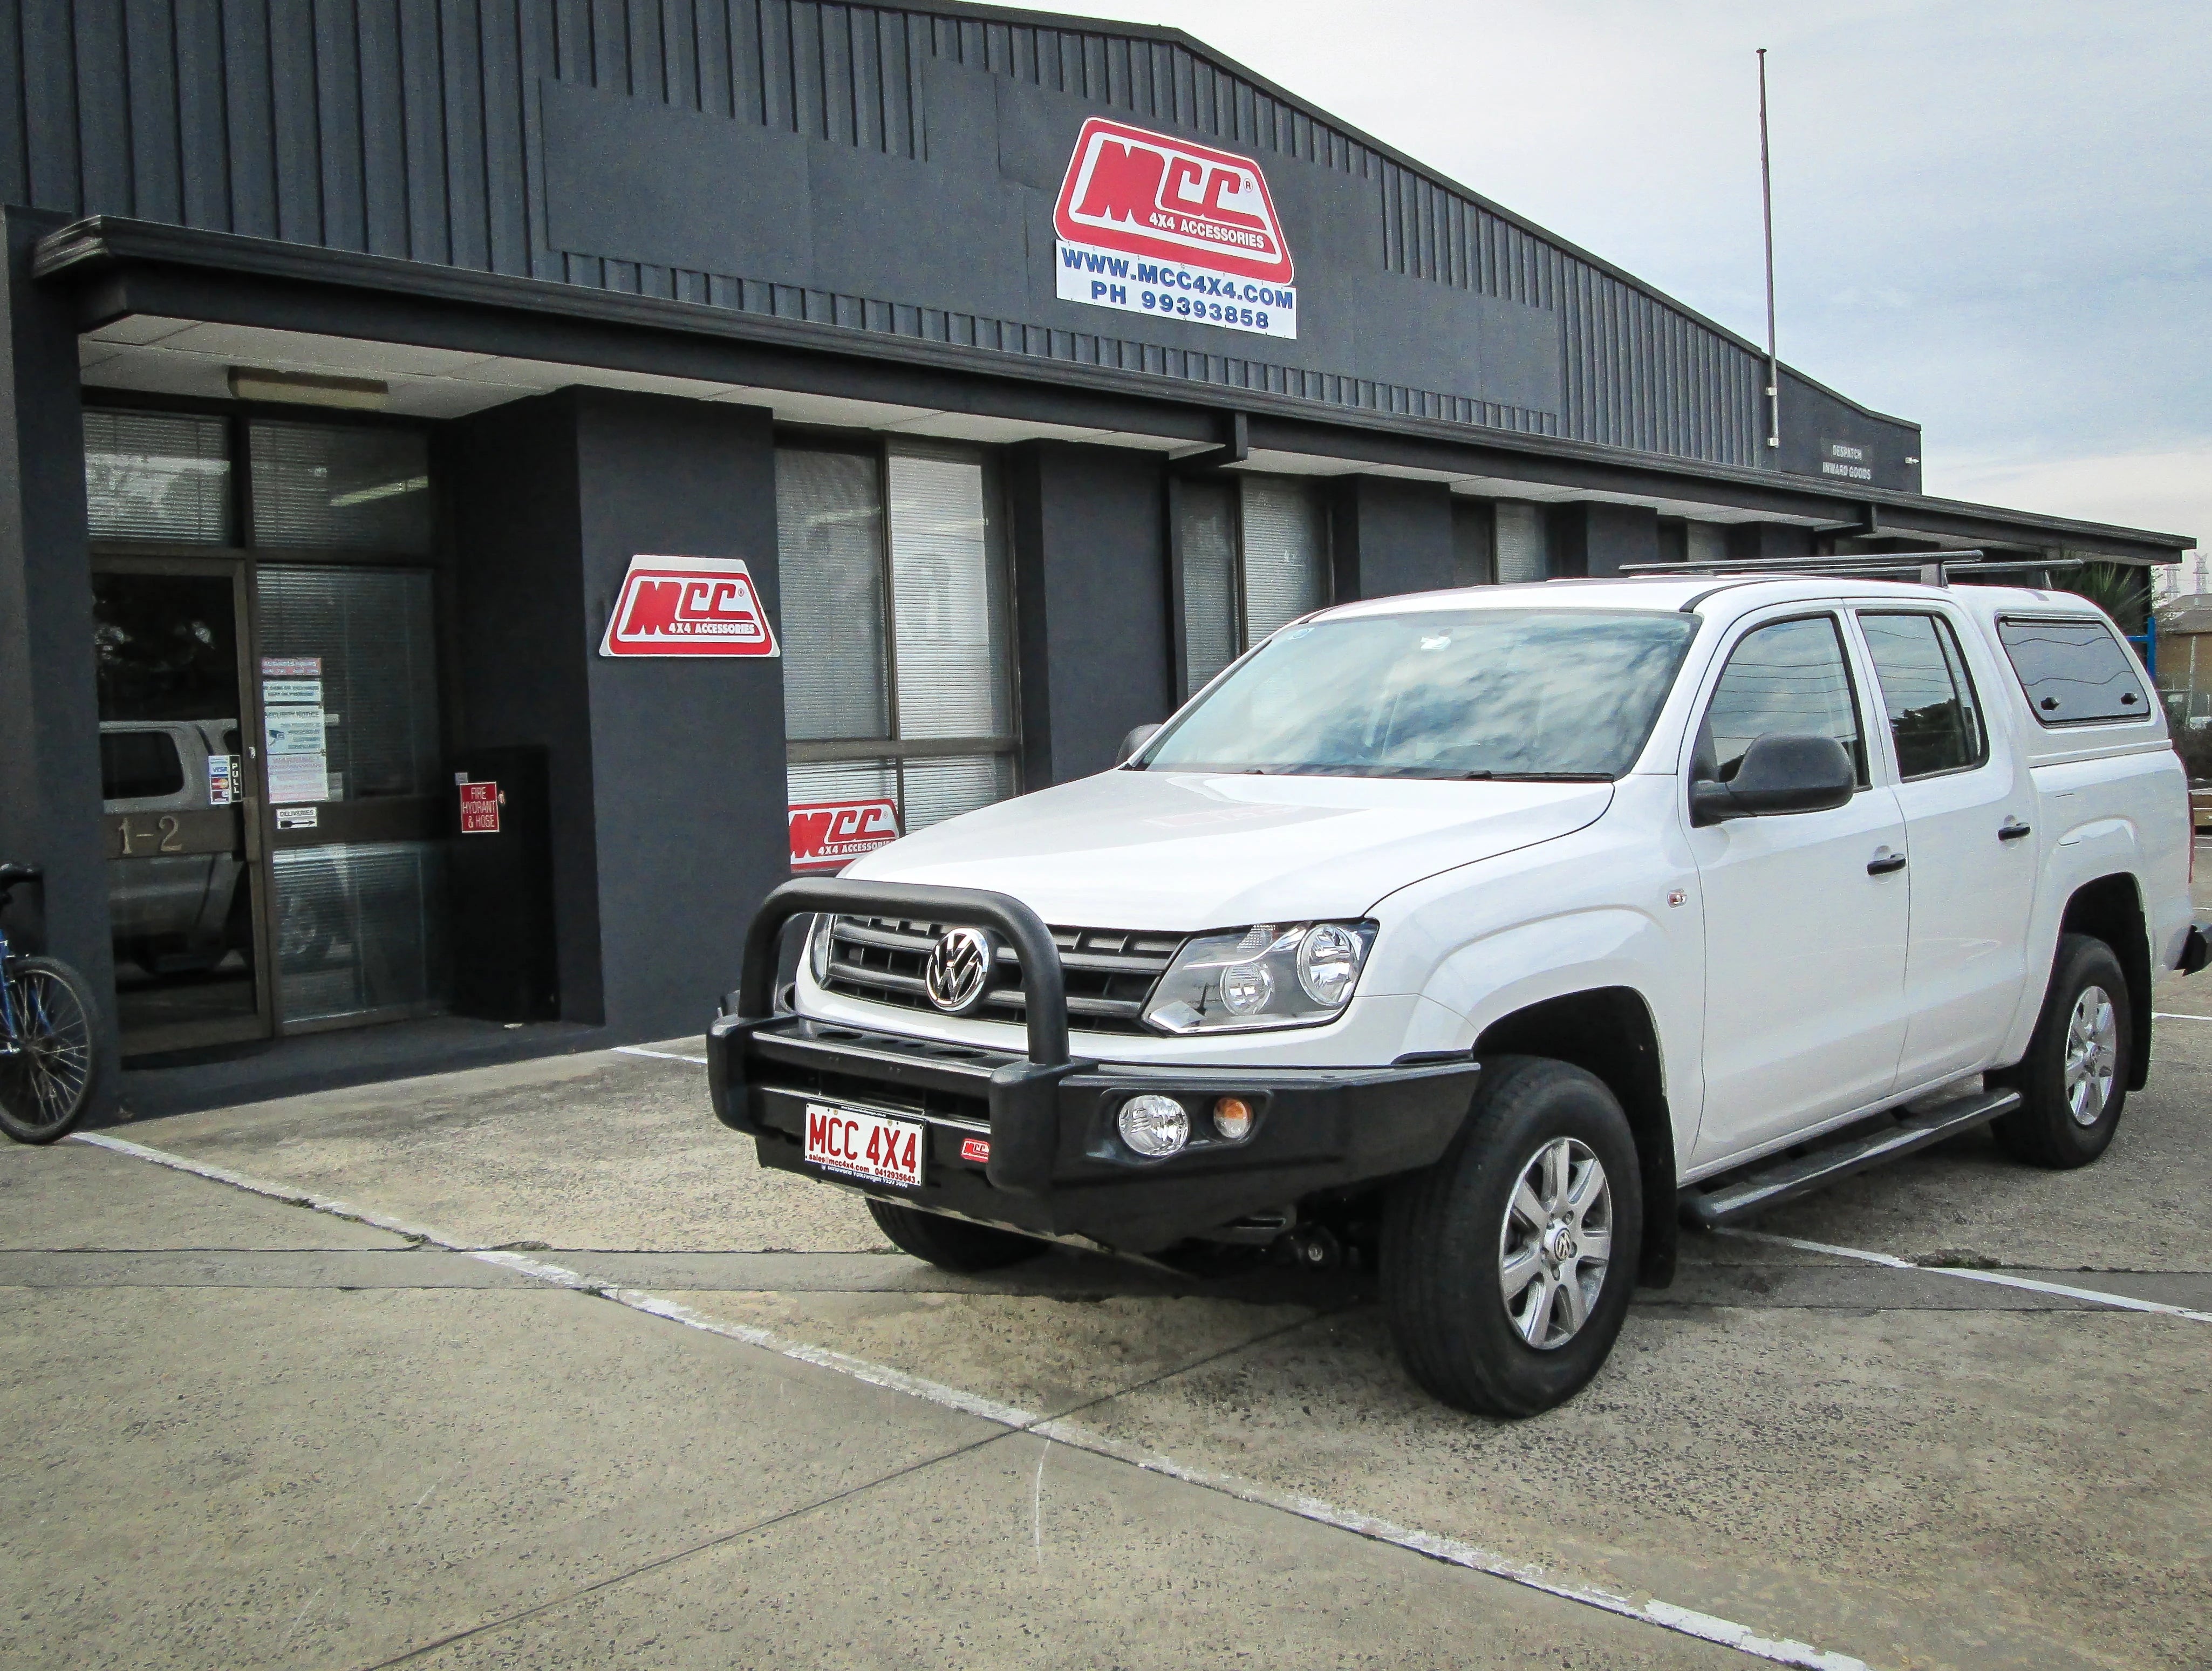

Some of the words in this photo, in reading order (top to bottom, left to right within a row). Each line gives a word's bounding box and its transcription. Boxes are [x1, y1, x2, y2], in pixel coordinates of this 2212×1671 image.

[1075, 140, 1267, 227] MCC
[1149, 212, 1176, 230] 4X4
[1180, 220, 1265, 249] ACCESSORIES
[1061, 247, 1293, 309] WWW.MCC4X4.COM
[1091, 280, 1127, 305] PH
[1142, 291, 1269, 330] 99393858
[622, 581, 754, 635] MCC
[668, 623, 691, 634] 4X4
[695, 624, 755, 635] ACCESSORIES
[462, 800, 496, 814] HYDRANT
[471, 787, 487, 800] FIRE
[468, 815, 474, 828] &
[475, 815, 495, 828] HOSE
[789, 808, 896, 859] MCC
[818, 845, 838, 855] 4X4
[809, 1113, 859, 1161] MCC
[866, 1125, 916, 1174] 4X4
[875, 1168, 916, 1184] 0412935643
